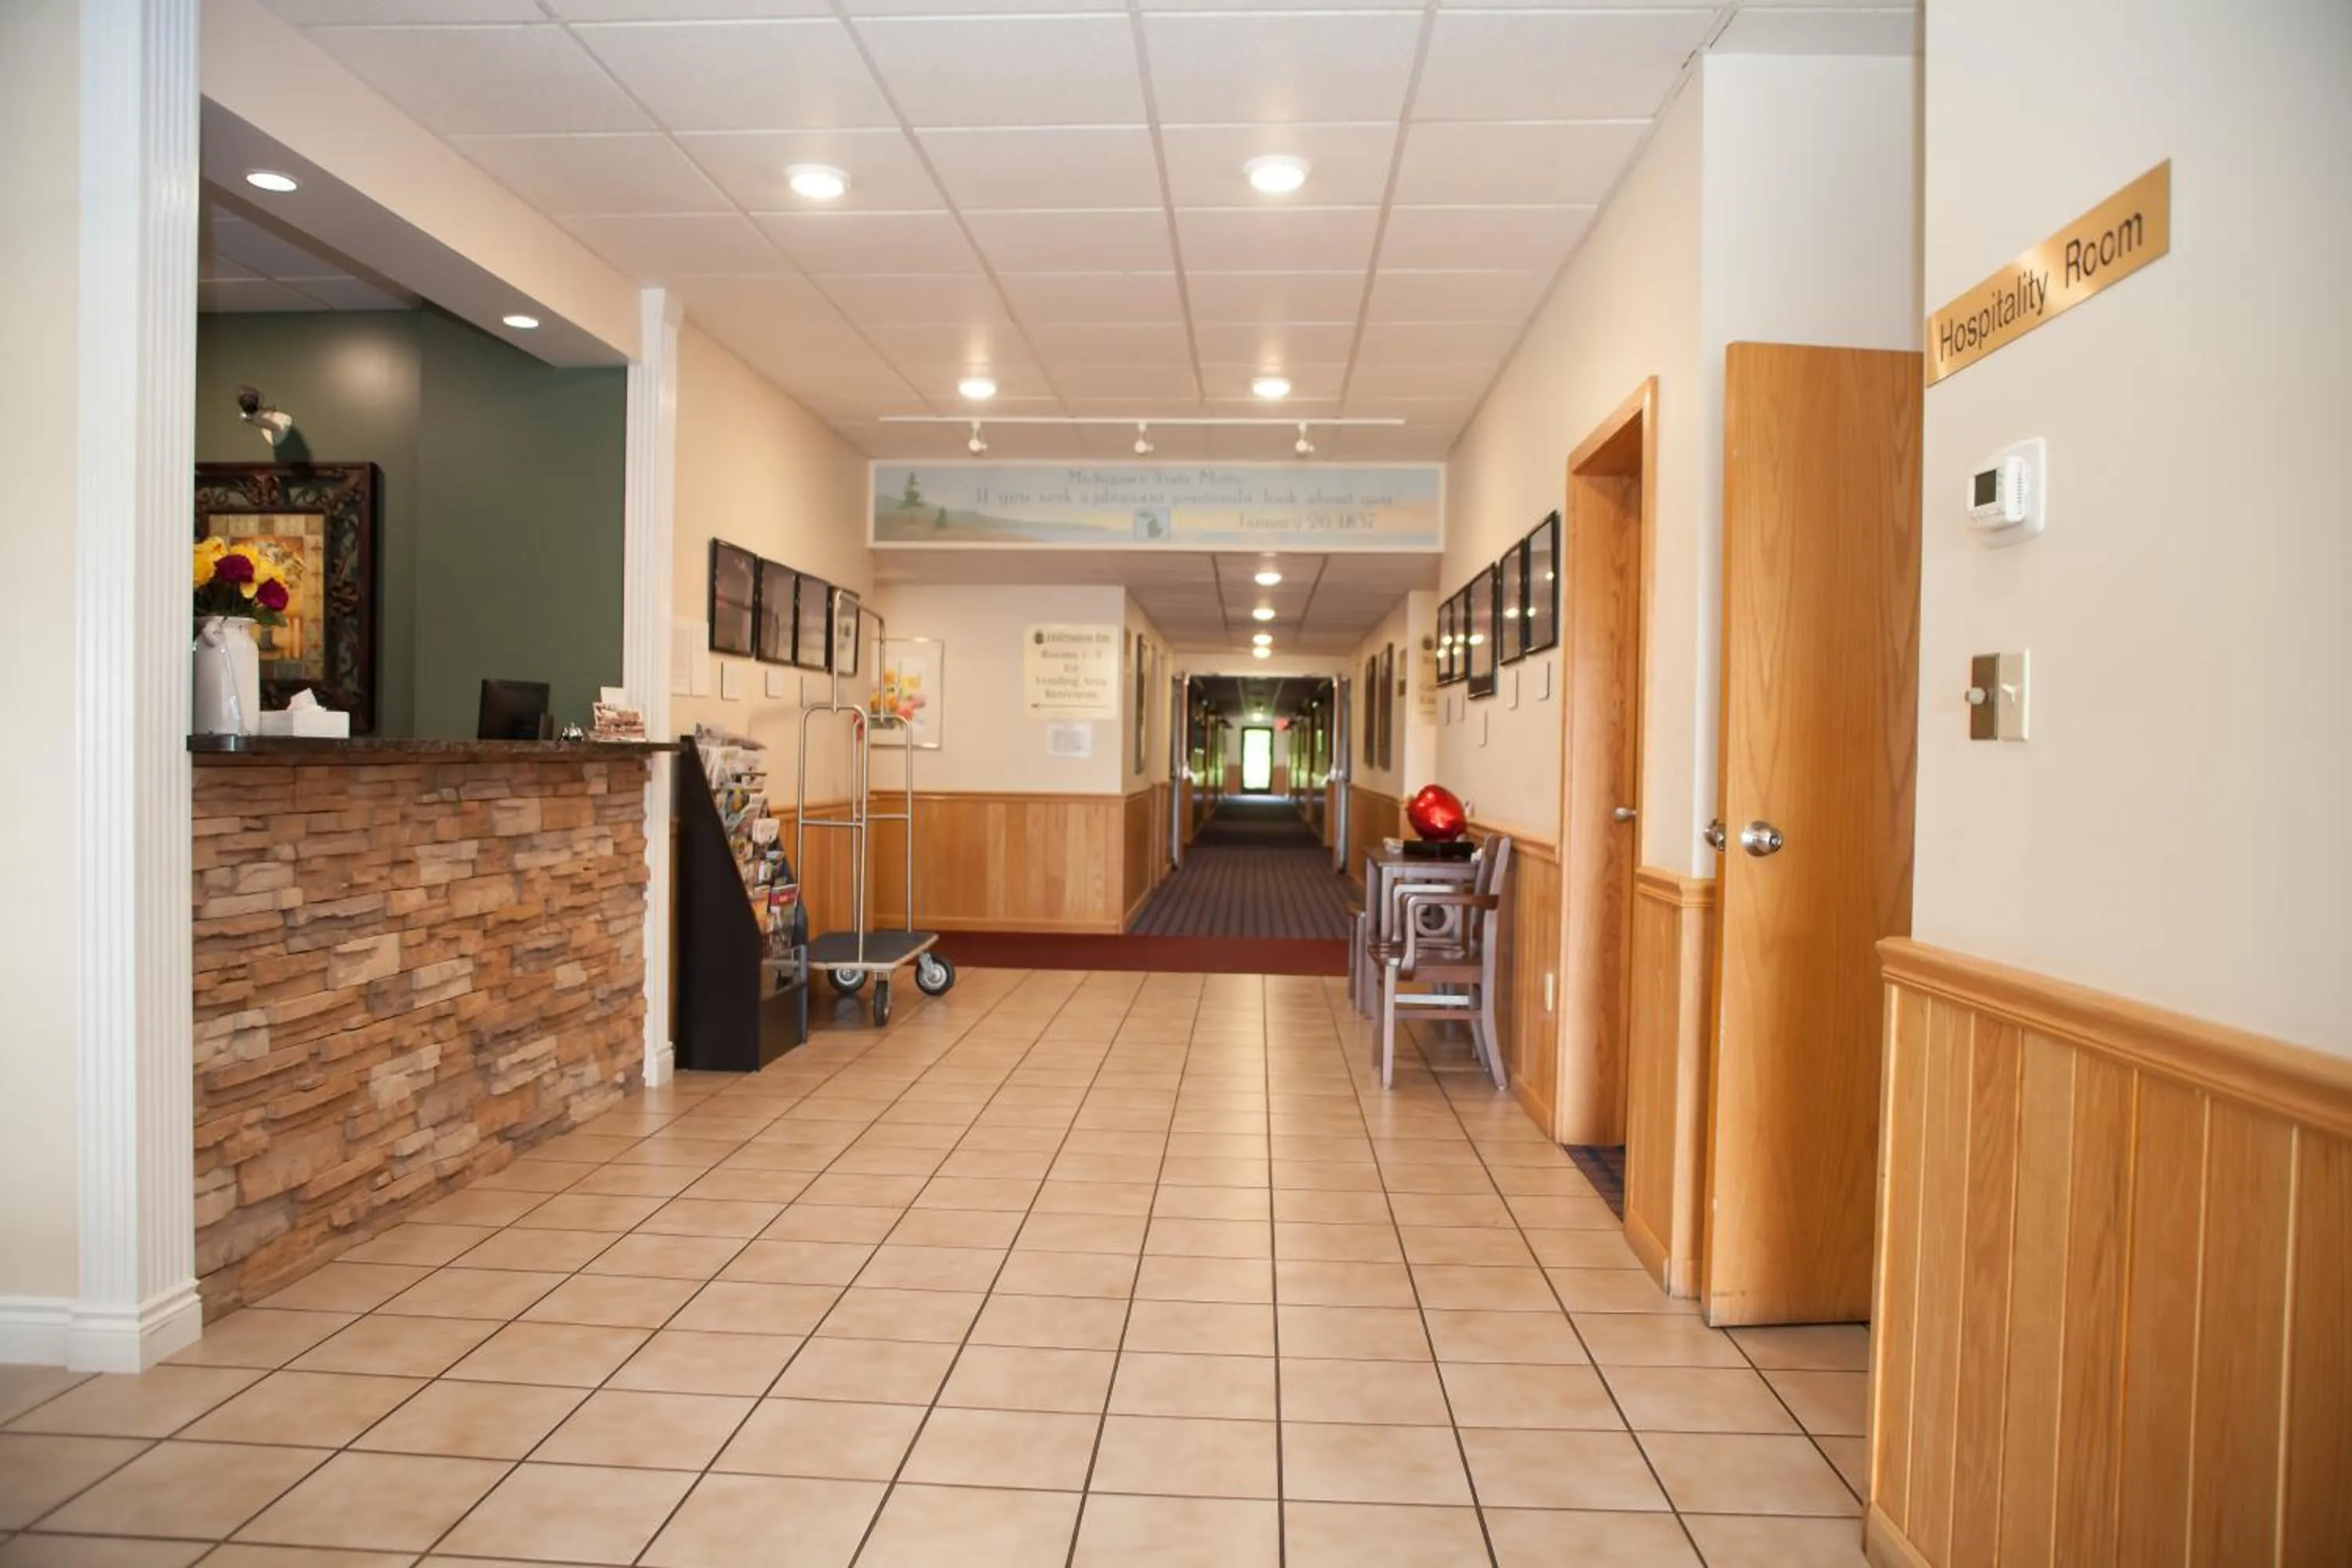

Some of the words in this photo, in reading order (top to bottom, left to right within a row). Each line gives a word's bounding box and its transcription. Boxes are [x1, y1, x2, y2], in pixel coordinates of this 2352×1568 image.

[1939, 270, 2048, 361] Hospitality
[2065, 212, 2143, 289] Room
[1262, 486, 1298, 504] look
[1238, 512, 1301, 534] January
